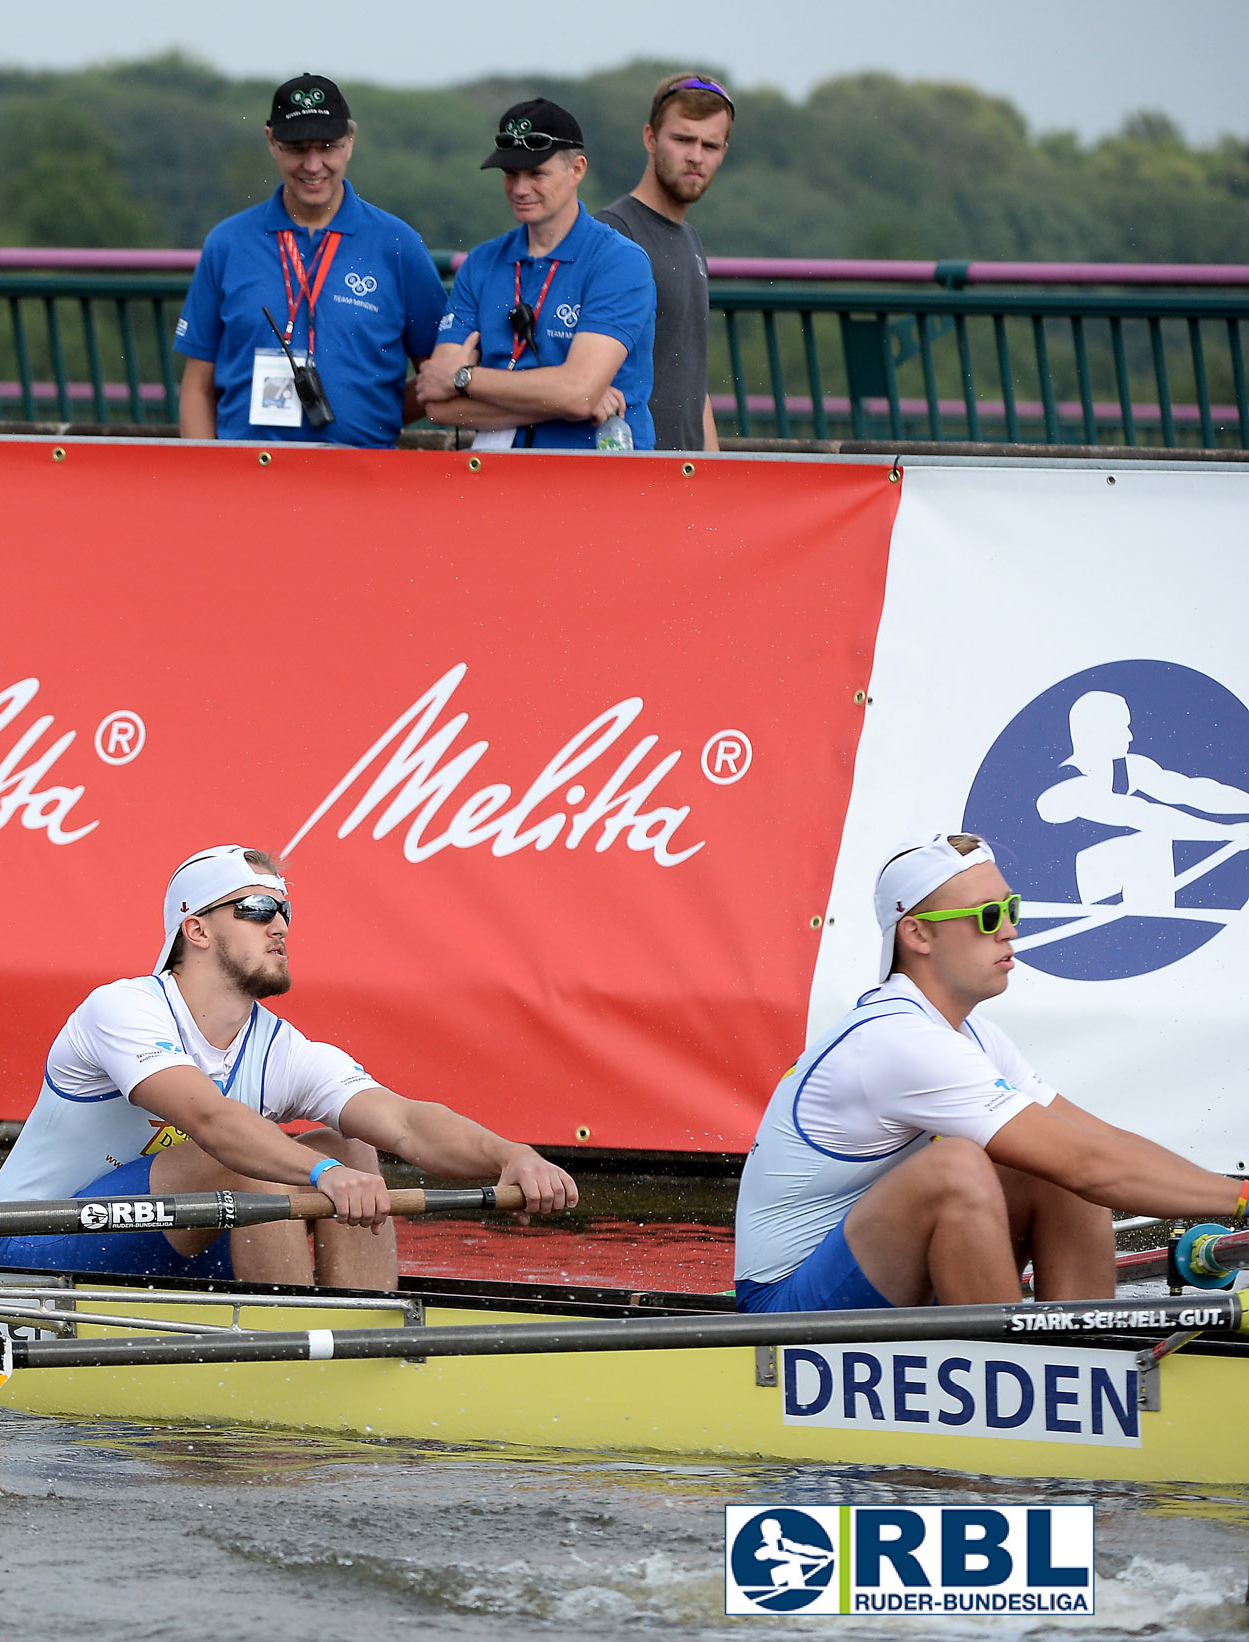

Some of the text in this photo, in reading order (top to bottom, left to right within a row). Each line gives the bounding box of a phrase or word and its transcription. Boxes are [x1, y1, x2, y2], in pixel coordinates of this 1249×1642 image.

[280, 663, 705, 866] Melitta
[112, 1201, 174, 1223] RBL
[1011, 1308, 1225, 1331] STARK. SCHNELL. GUT.
[784, 1348, 1139, 1438] DRESDEN
